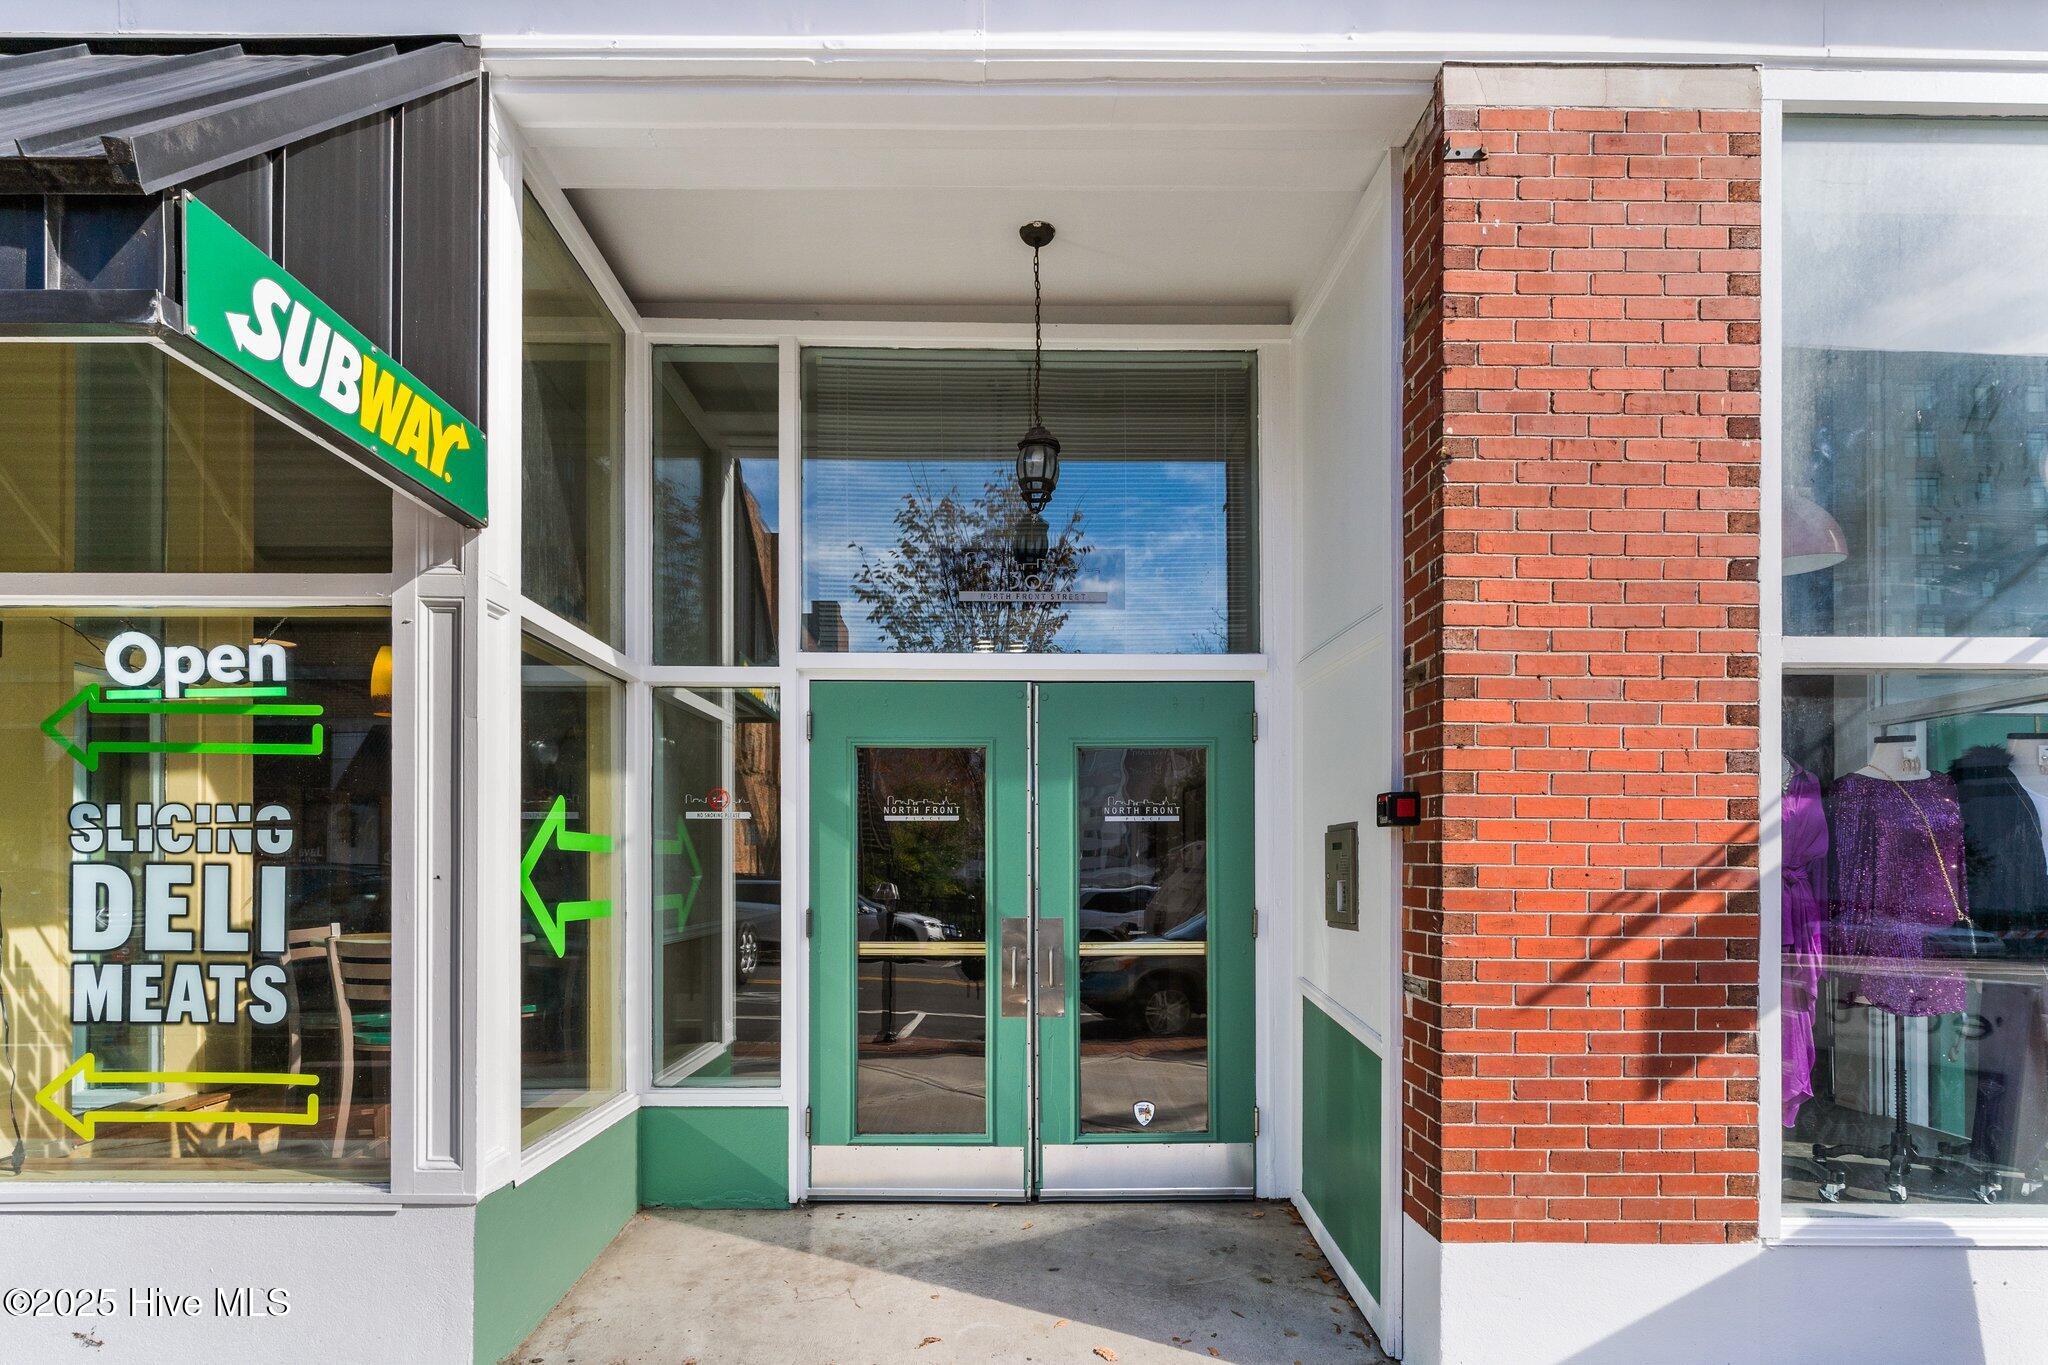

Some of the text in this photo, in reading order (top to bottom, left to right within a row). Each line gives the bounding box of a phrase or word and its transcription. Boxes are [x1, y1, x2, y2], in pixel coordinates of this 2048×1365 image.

[225, 278, 470, 482] SUBWAY
[980, 592, 1086, 600] NORTH FRONT STREET
[104, 631, 288, 699] Open
[69, 802, 294, 855] SLICING
[883, 806, 961, 814] NORTH FRONT
[1104, 806, 1181, 814] NORTH FRONT
[70, 862, 288, 954] DELI
[72, 963, 288, 1025] MEATS
